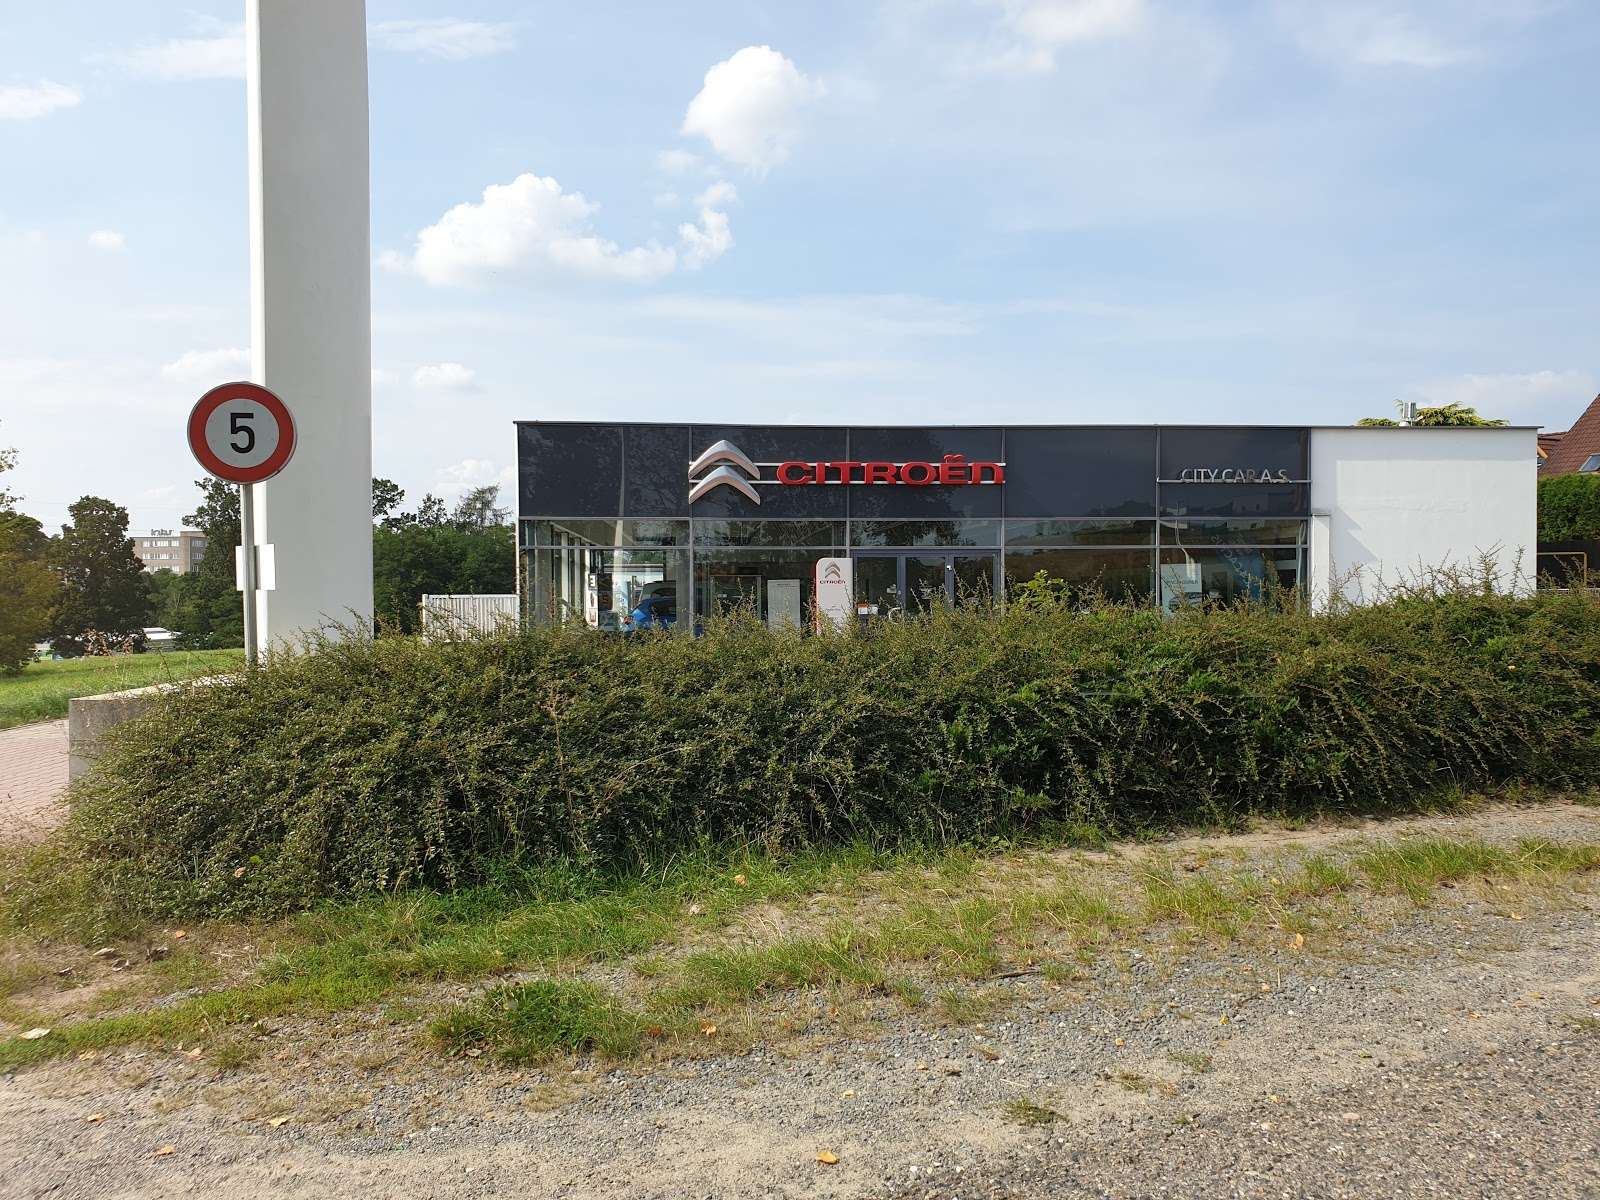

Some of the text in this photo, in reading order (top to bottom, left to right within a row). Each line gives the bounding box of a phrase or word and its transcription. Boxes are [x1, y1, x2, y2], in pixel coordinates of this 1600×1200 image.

[230, 412, 256, 454] 5
[1180, 468, 1219, 484] CITY
[1221, 468, 1256, 484] CAR
